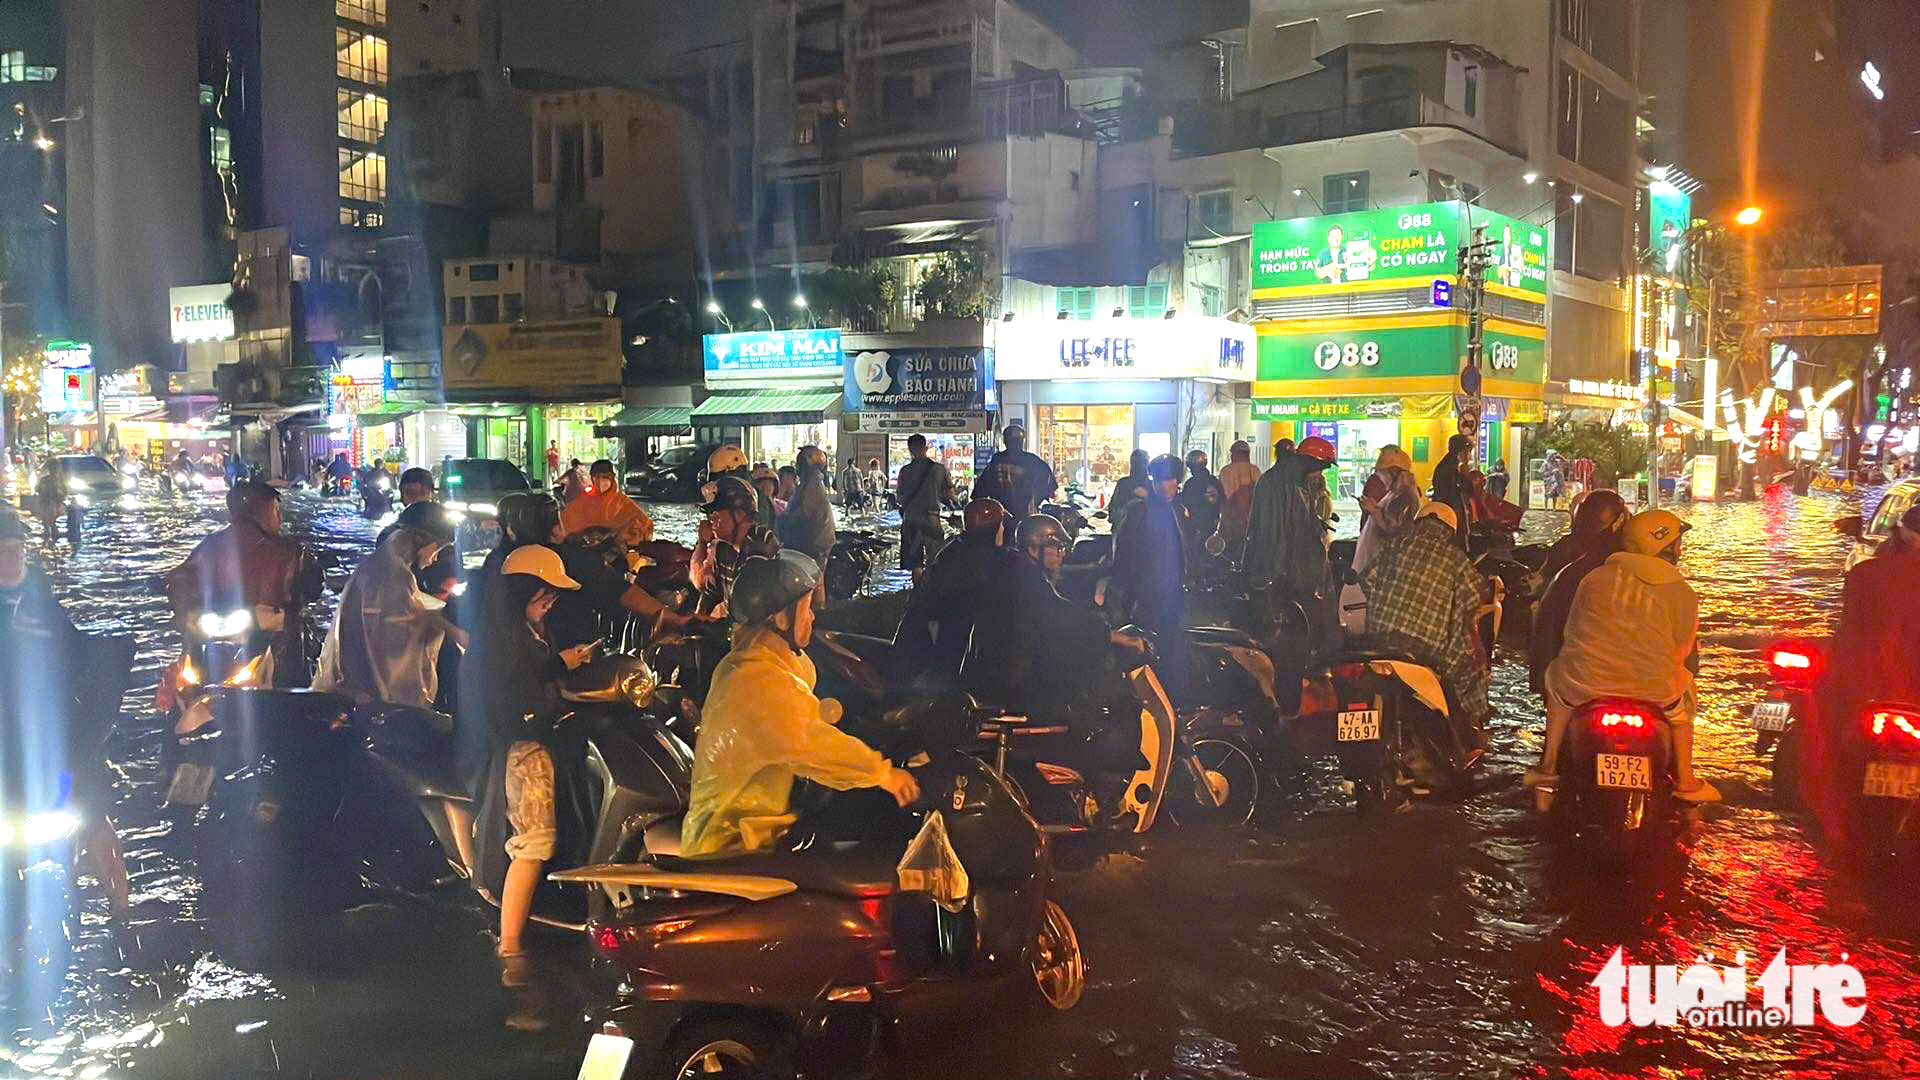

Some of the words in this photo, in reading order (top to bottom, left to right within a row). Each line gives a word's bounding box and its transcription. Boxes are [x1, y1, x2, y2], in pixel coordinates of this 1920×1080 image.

[1398, 213, 1431, 229] F88
[1380, 236, 1424, 253] CHẠM
[1427, 231, 1446, 247] LÀ
[1260, 251, 1281, 262] HẠN
[1285, 245, 1310, 257] MỨC
[1380, 253, 1401, 268] CÓ
[1406, 250, 1448, 265] NGAY
[1260, 262, 1298, 274] TRONG
[1301, 259, 1320, 270] TAY
[740, 340, 785, 356] KIM
[792, 338, 839, 355] MAI
[1314, 342, 1380, 370] F88
[1492, 341, 1518, 370] F88
[1256, 405, 1270, 414] VAY
[1272, 404, 1298, 415] NHANH
[1338, 404, 1349, 414] XE
